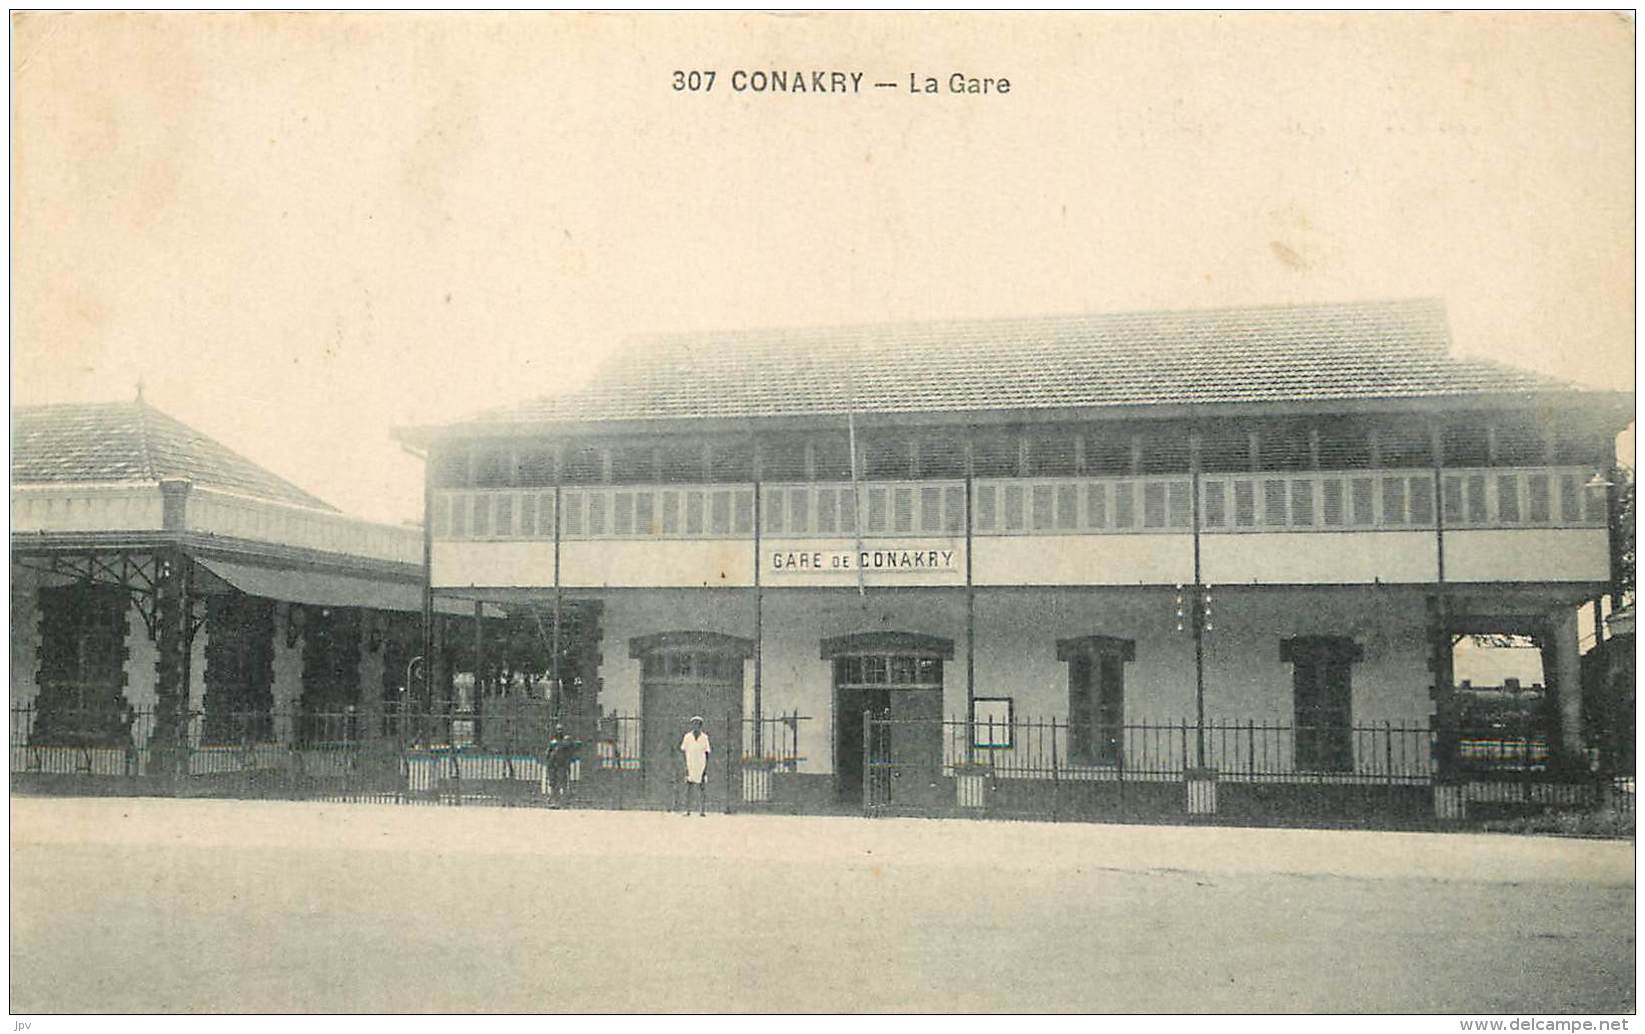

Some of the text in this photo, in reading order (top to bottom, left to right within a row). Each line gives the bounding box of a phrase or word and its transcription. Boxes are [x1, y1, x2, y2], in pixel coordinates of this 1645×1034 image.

[773, 551, 954, 569] GARE DE CONAKRY
